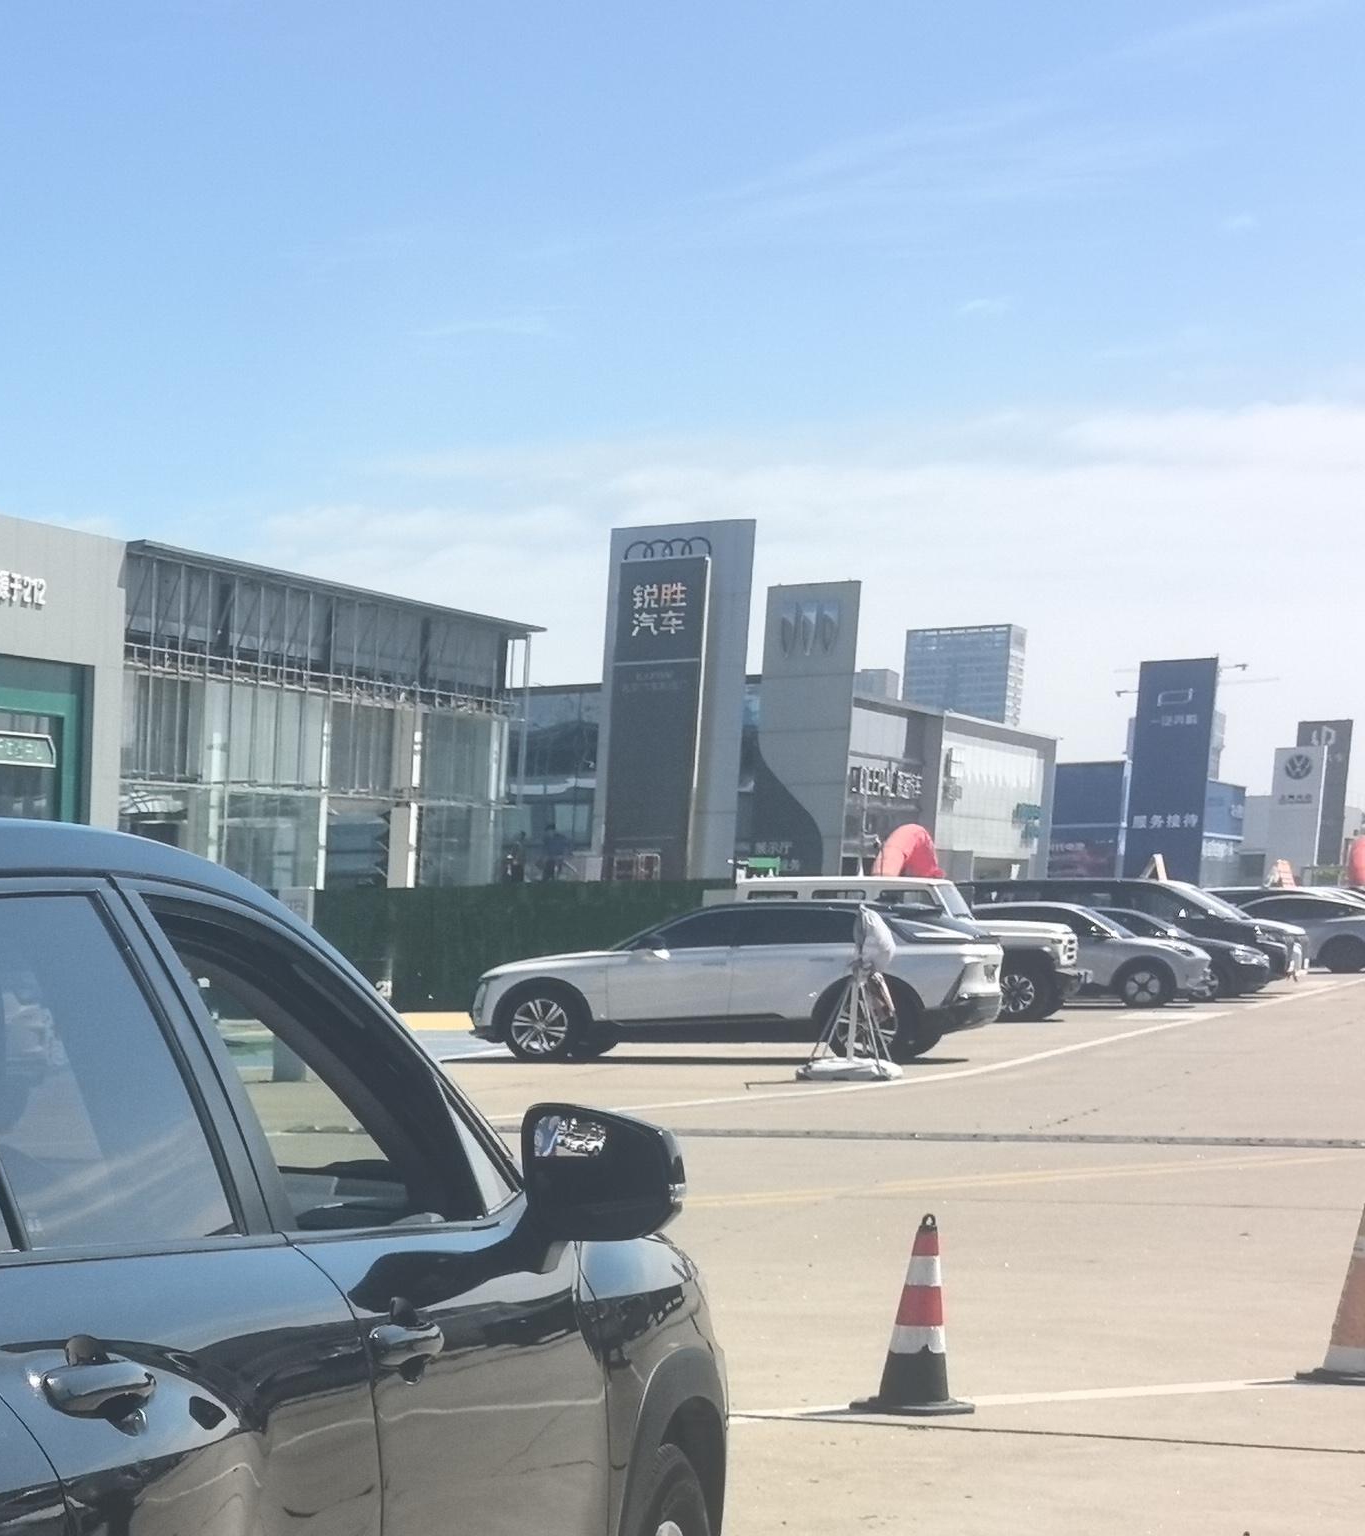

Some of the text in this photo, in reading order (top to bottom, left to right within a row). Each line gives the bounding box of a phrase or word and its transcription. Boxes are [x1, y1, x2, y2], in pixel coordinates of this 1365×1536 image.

[633, 582, 687, 609] 锐胜
[631, 610, 685, 636] 汽车
[1132, 814, 1199, 829] 服务接待
